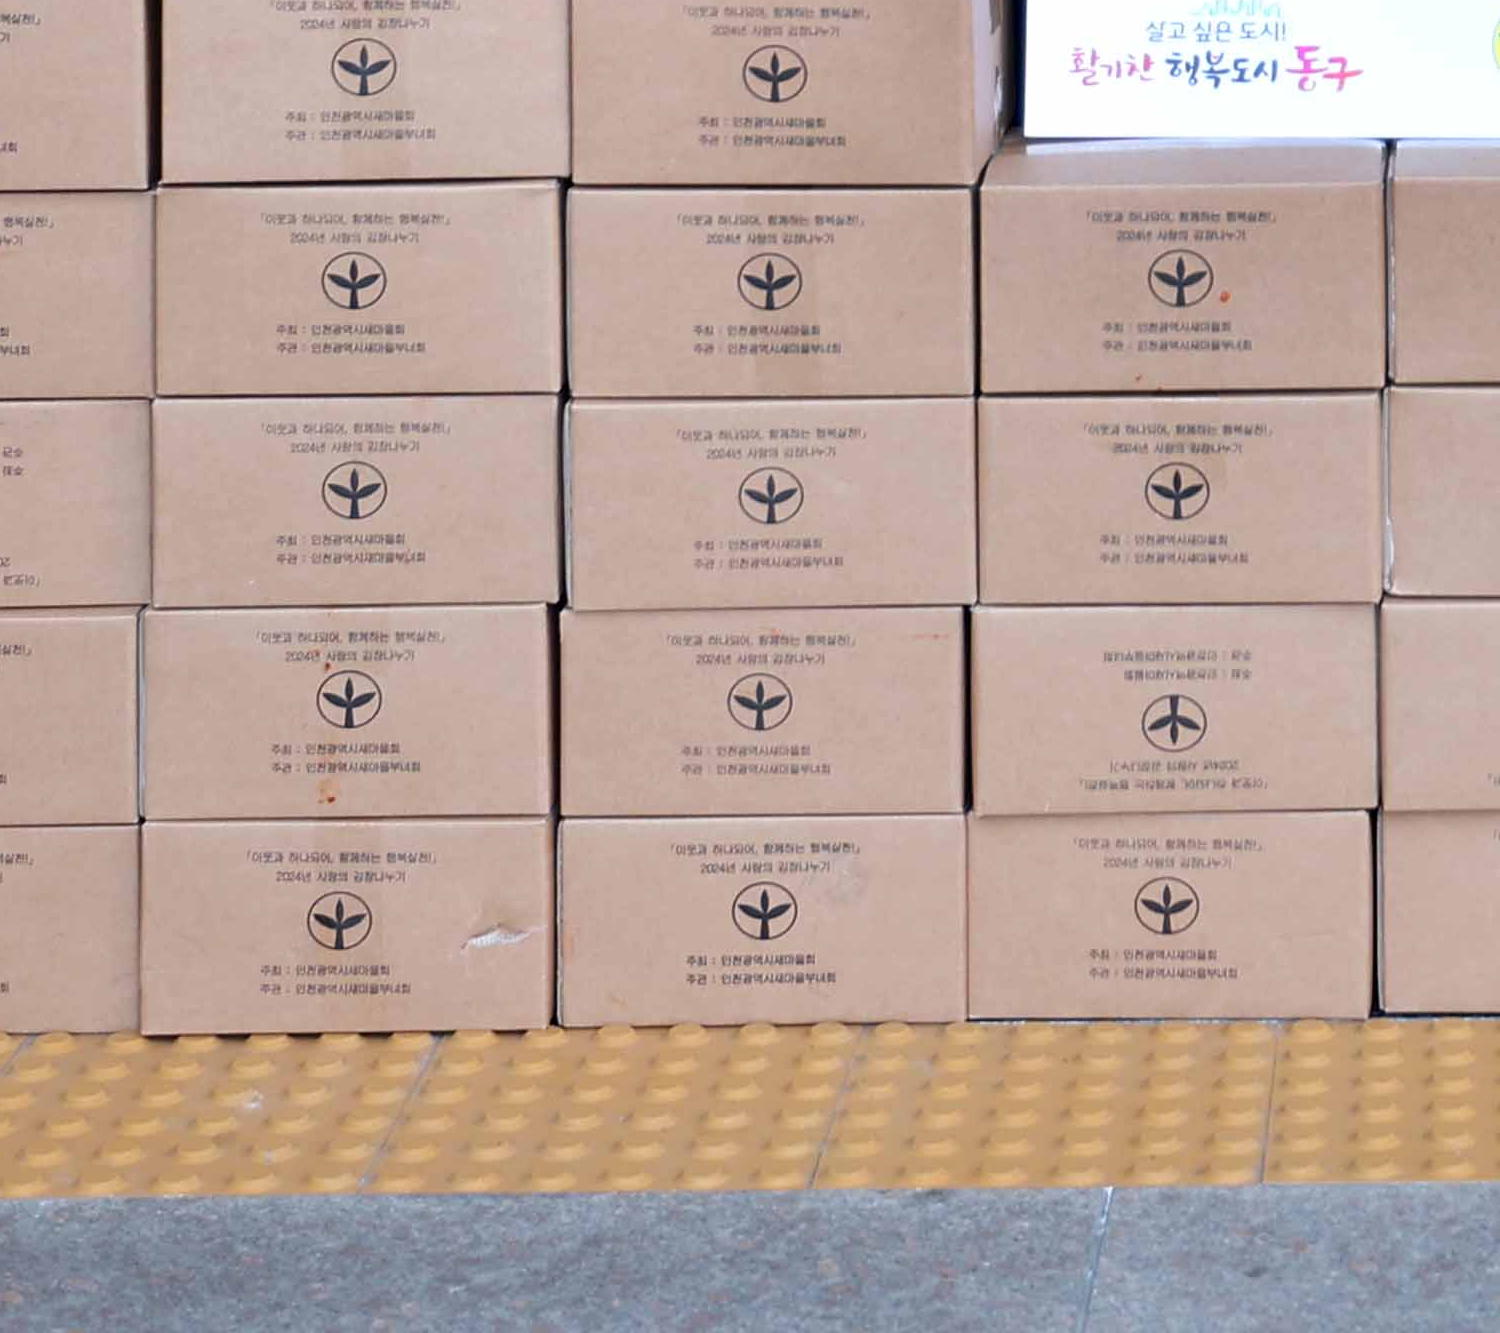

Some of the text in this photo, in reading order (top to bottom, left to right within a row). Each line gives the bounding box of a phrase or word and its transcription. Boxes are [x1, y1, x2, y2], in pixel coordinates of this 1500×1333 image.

[1145, 20, 1187, 43] 살고
[1193, 20, 1233, 43] 싶은
[1069, 45, 1365, 92] 활기찬 행복도시 동구
